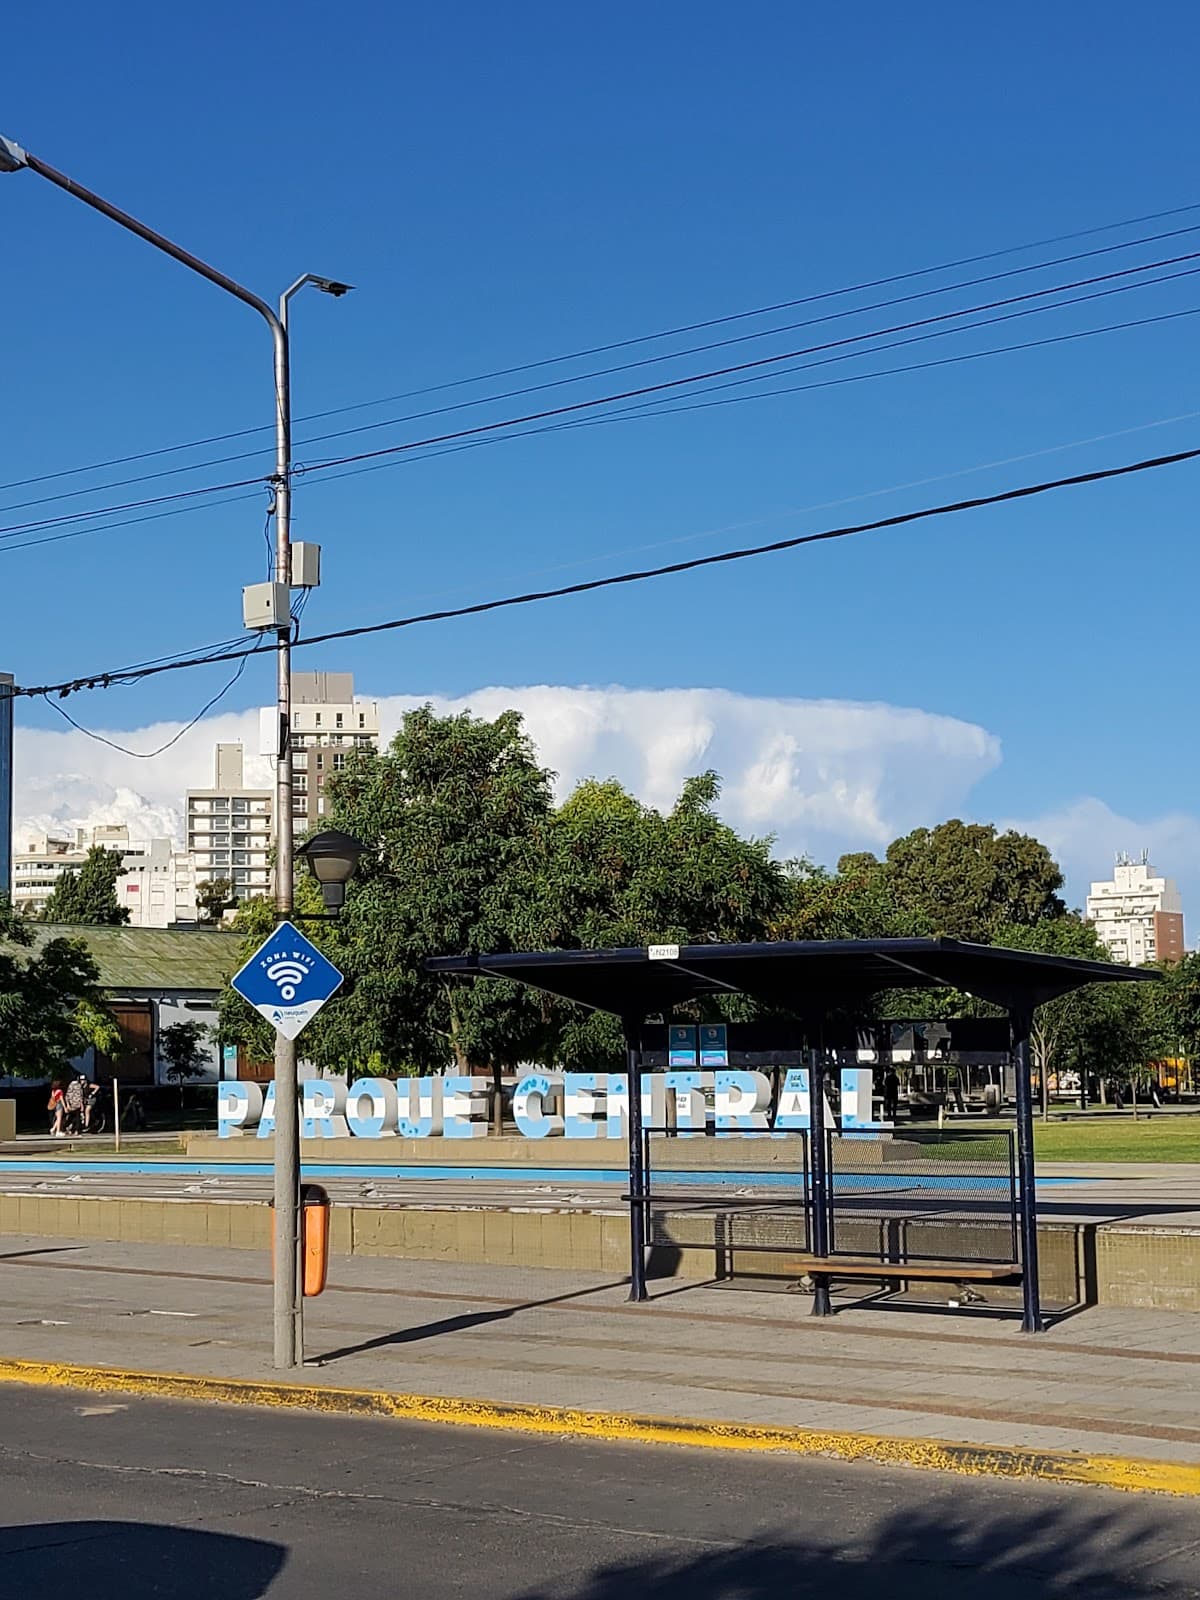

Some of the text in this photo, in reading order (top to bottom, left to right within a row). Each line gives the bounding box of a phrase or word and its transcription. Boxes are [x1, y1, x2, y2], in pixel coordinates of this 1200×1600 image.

[259, 951, 316, 969] ZONA WIFI
[512, 1068, 894, 1140] CENTRAL
